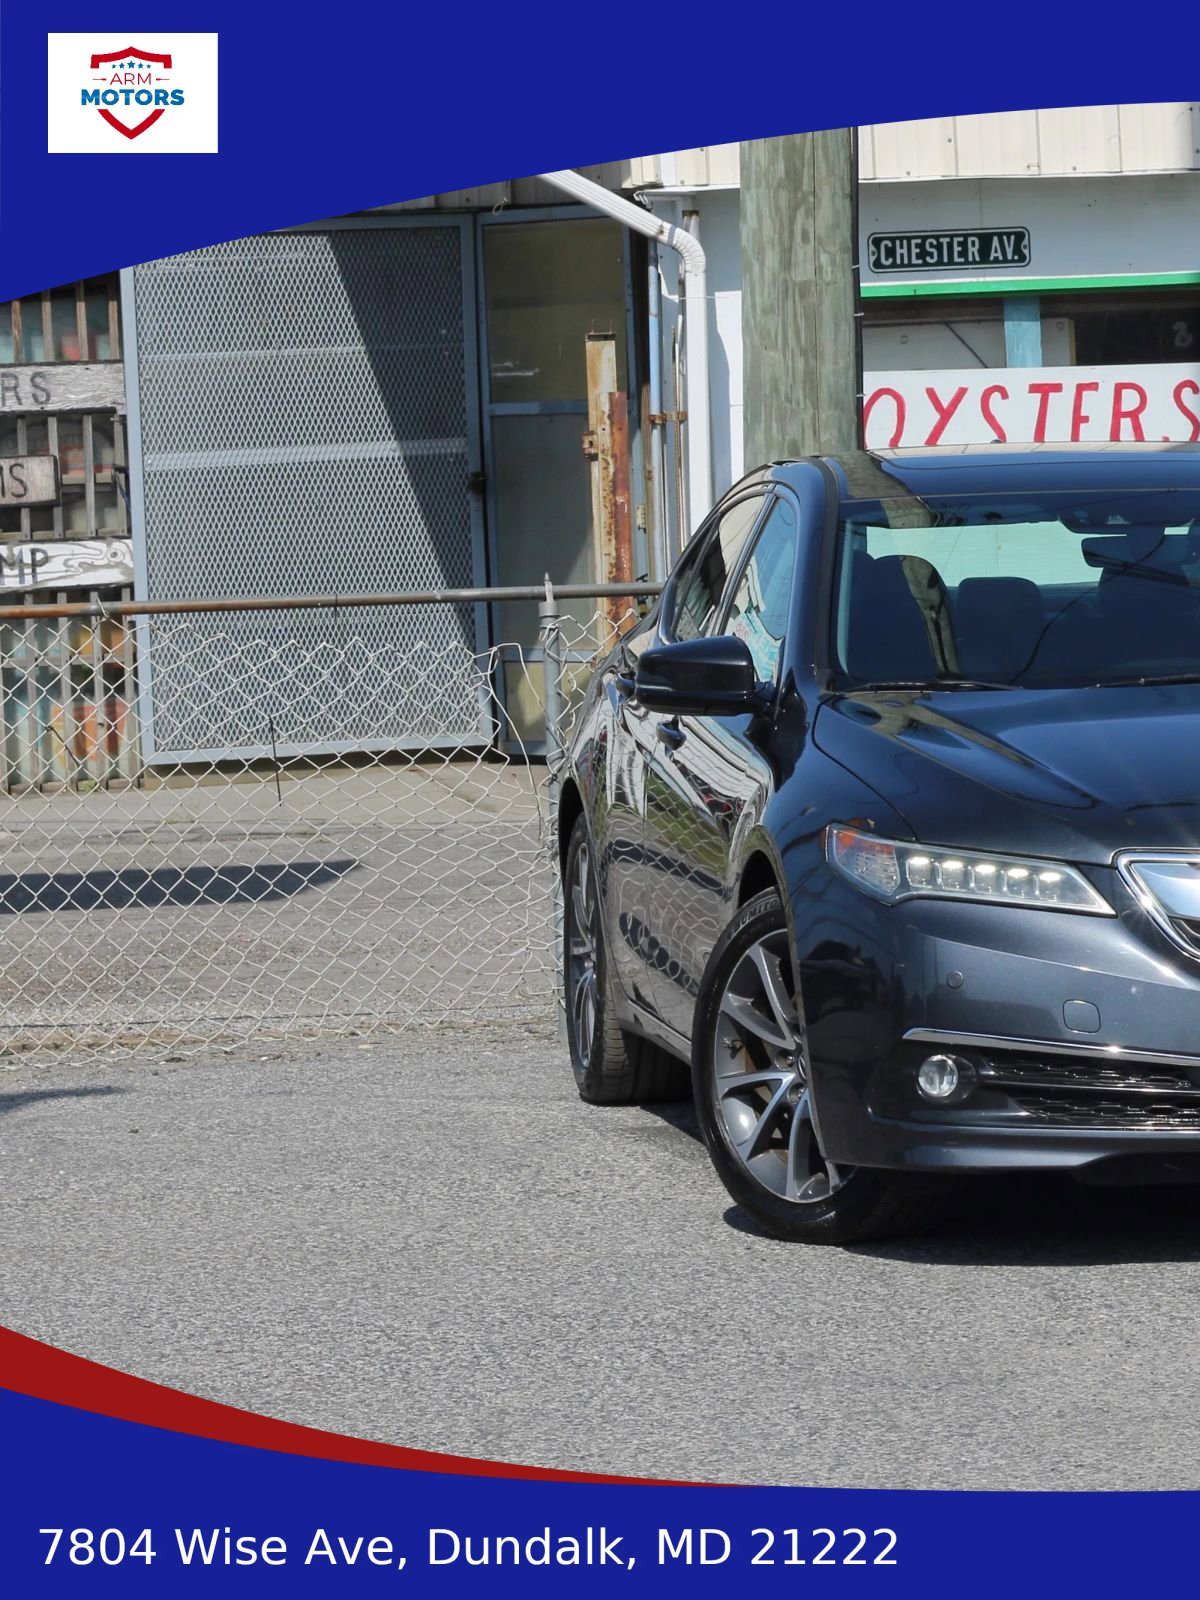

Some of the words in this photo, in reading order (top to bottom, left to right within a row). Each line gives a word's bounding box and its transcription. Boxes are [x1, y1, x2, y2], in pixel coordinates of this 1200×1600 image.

[880, 236, 980, 266] CHESTER
[989, 234, 1019, 261] AV.
[864, 379, 1200, 447] OYSTERS
